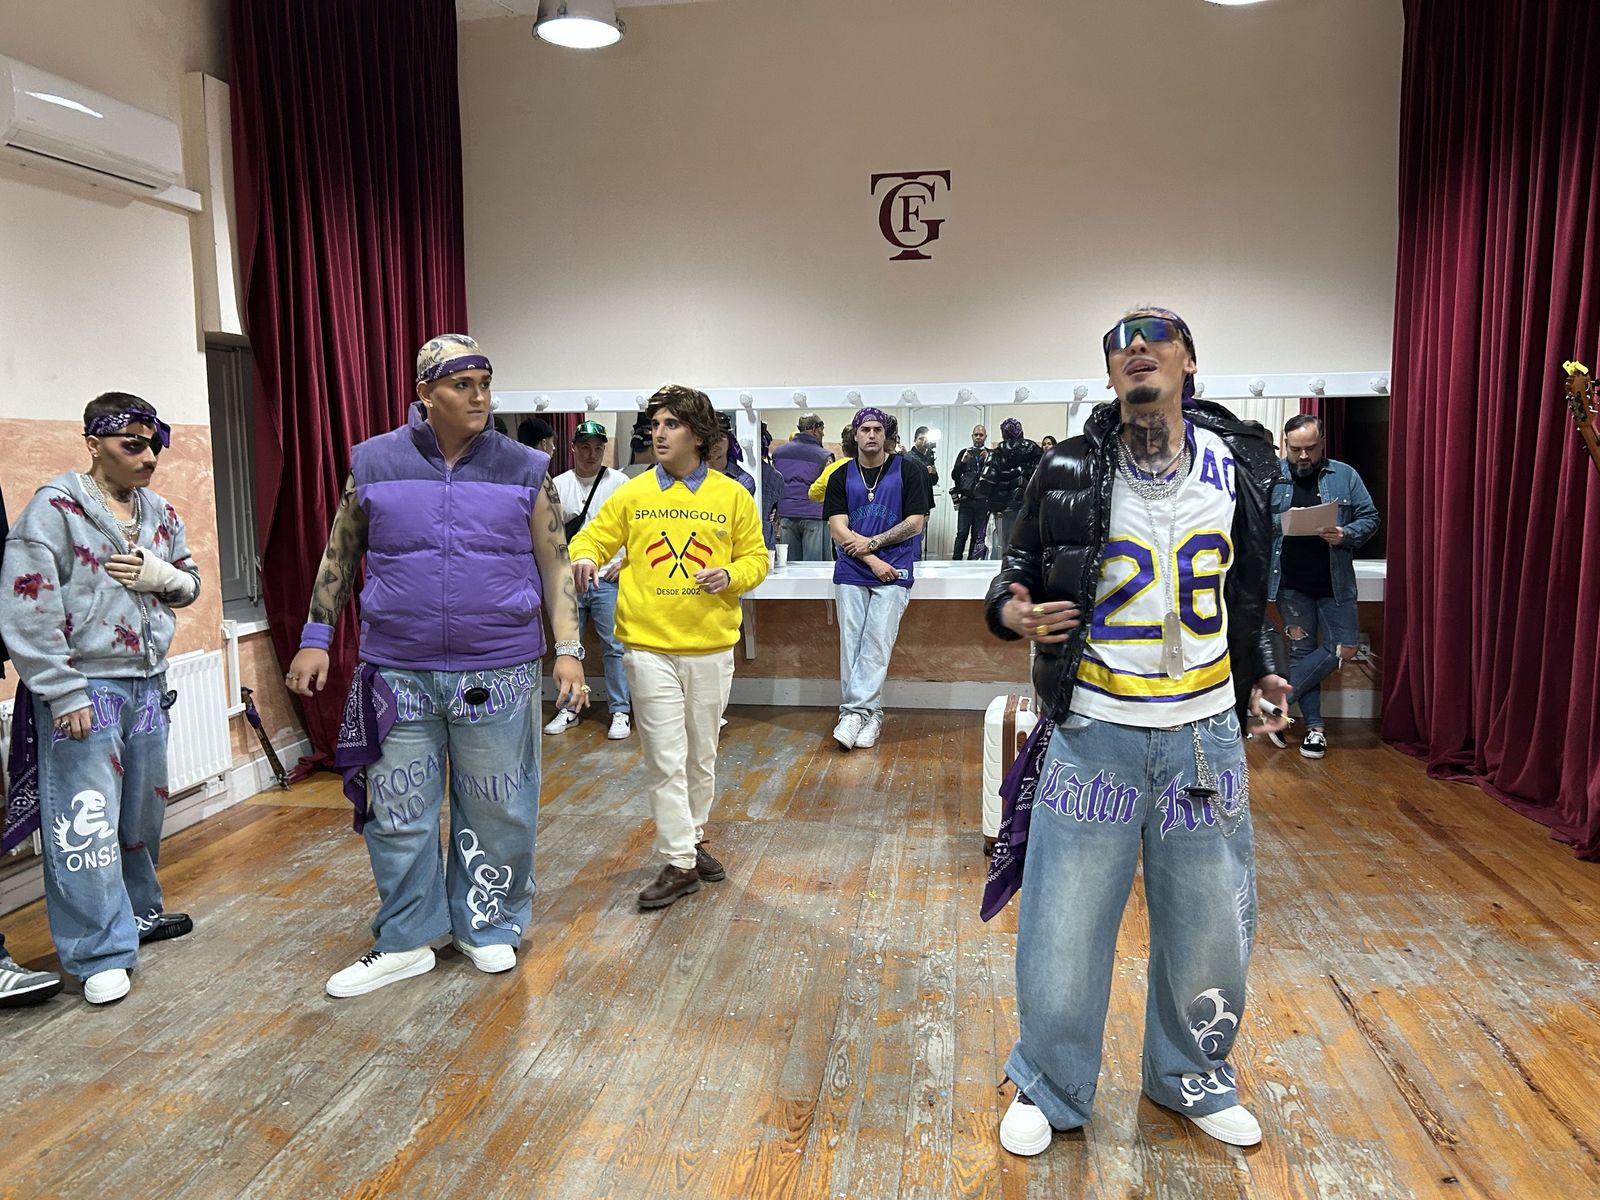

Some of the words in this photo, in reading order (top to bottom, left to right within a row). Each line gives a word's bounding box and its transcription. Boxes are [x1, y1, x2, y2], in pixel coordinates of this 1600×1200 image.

[635, 508, 727, 524] SPAMONGOLO
[681, 587, 701, 596] 2002
[1087, 529, 1234, 644] 26
[1033, 758, 1144, 824] Latin
[387, 795, 425, 832] NO
[66, 842, 118, 872] ONSE
